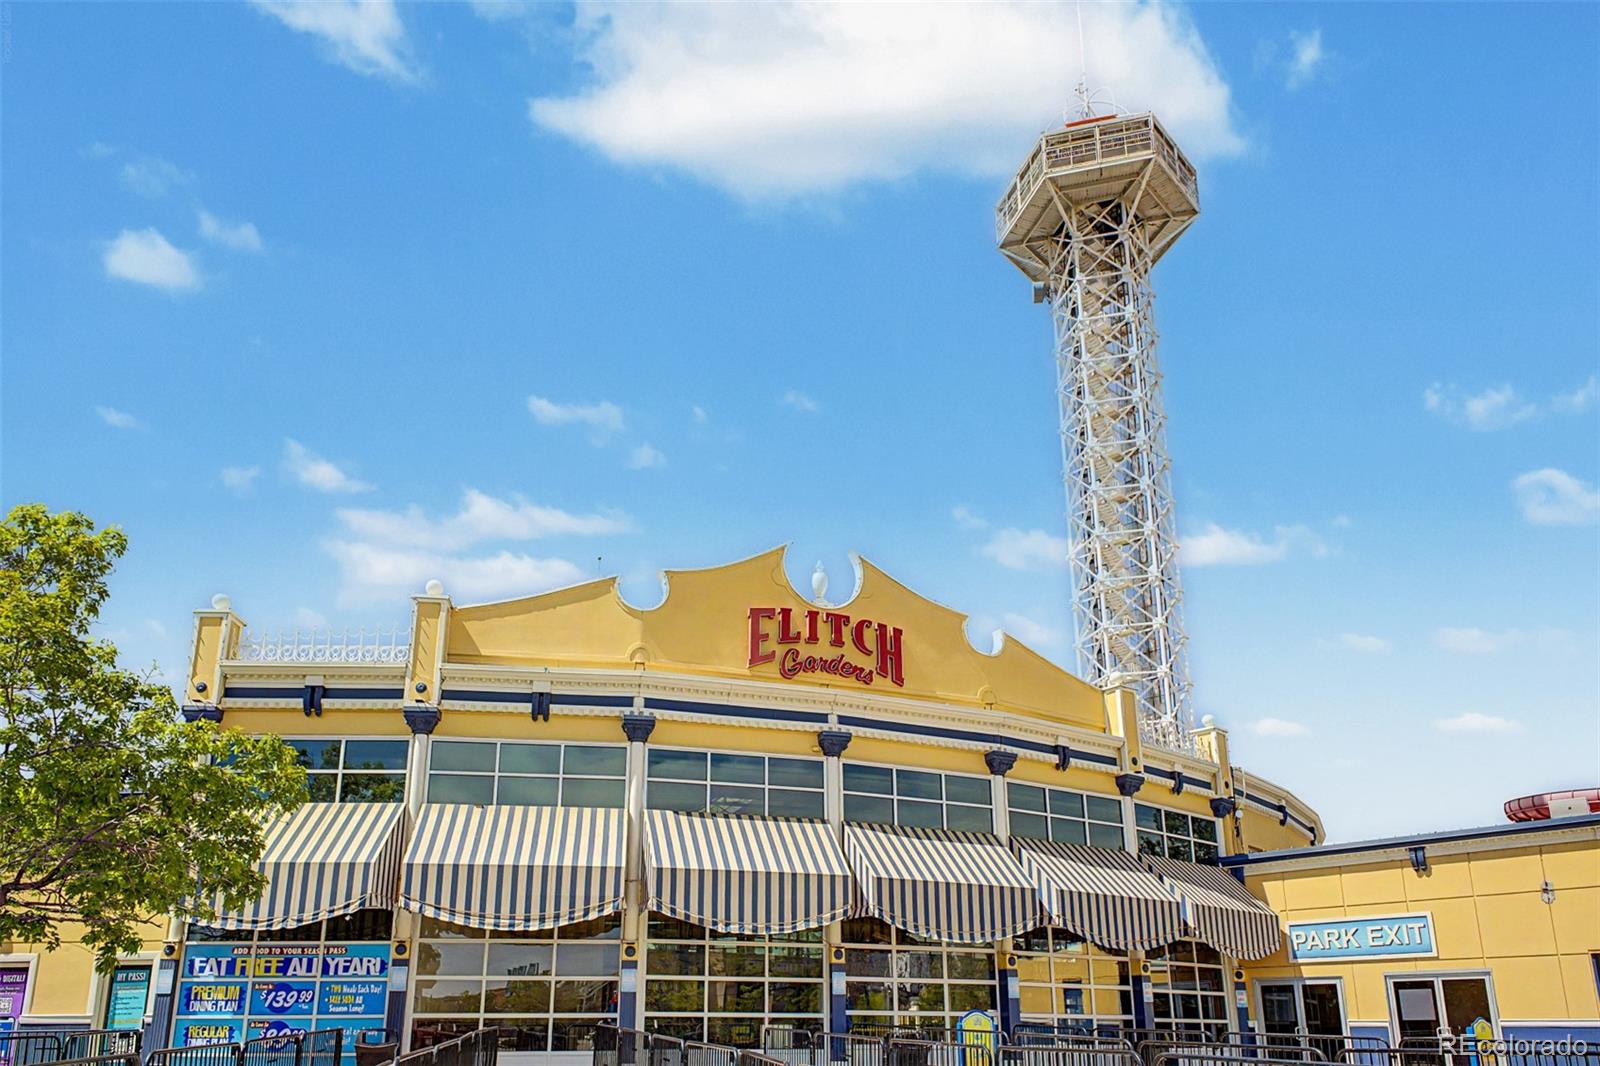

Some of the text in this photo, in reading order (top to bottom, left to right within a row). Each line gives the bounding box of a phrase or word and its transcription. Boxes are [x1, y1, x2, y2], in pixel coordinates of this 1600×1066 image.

[746, 607, 905, 687] ELITCH
[780, 648, 874, 685] Gardens
[1291, 922, 1426, 950] PARK EXIT
[233, 947, 249, 955] ADD
[271, 947, 281, 955] TO
[282, 947, 302, 955] YOUR
[303, 947, 328, 955] SEASN
[329, 947, 346, 955] PASS
[192, 956, 381, 976] EAT FREE ALL YEAR!
[117, 973, 127, 981] MY
[191, 985, 241, 1000] PREMIUM
[189, 1000, 238, 1012] DINING PLAN
[188, 1025, 230, 1038] REGULAR
